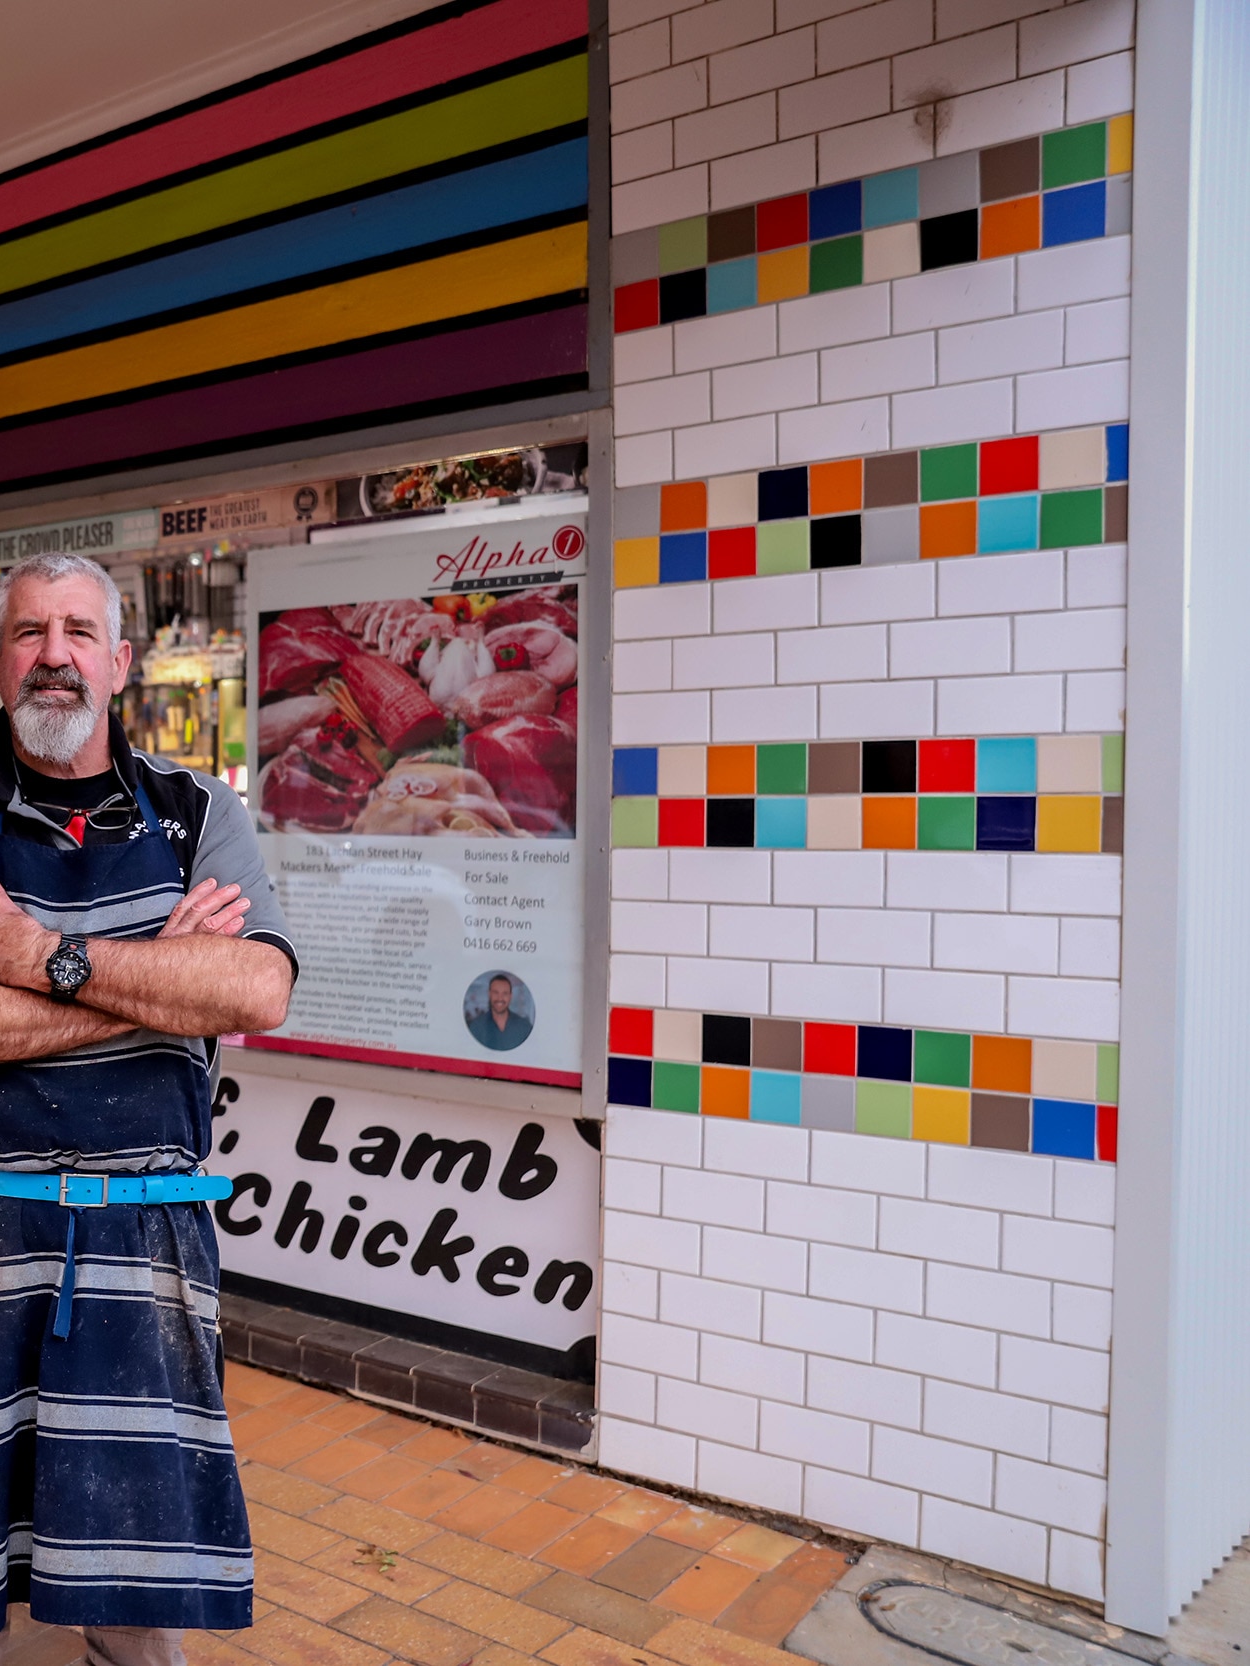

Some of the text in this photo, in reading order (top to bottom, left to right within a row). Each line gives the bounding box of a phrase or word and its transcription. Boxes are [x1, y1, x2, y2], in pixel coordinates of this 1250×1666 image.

[209, 499, 260, 516] THE GREATEST
[162, 507, 207, 536] BEEF
[209, 511, 267, 531] MEAT ON EARTH
[18, 530, 60, 558] CROWD
[62, 521, 113, 551] PLEASER
[433, 535, 553, 582] Alpha
[128, 818, 187, 840] MAERS
[306, 845, 323, 857] 183
[367, 846, 399, 859] Street
[402, 847, 422, 861] Hay
[464, 848, 570, 864] Business & Freehold
[280, 861, 321, 873] Mackers
[409, 865, 432, 877] Sale
[465, 870, 509, 884] For Sale
[464, 892, 545, 910] Contact Agent
[464, 914, 532, 930] Gary Brown
[463, 936, 538, 953] 0416 662 669
[295, 1096, 558, 1200] Lamb
[214, 1173, 593, 1311] Chicken
